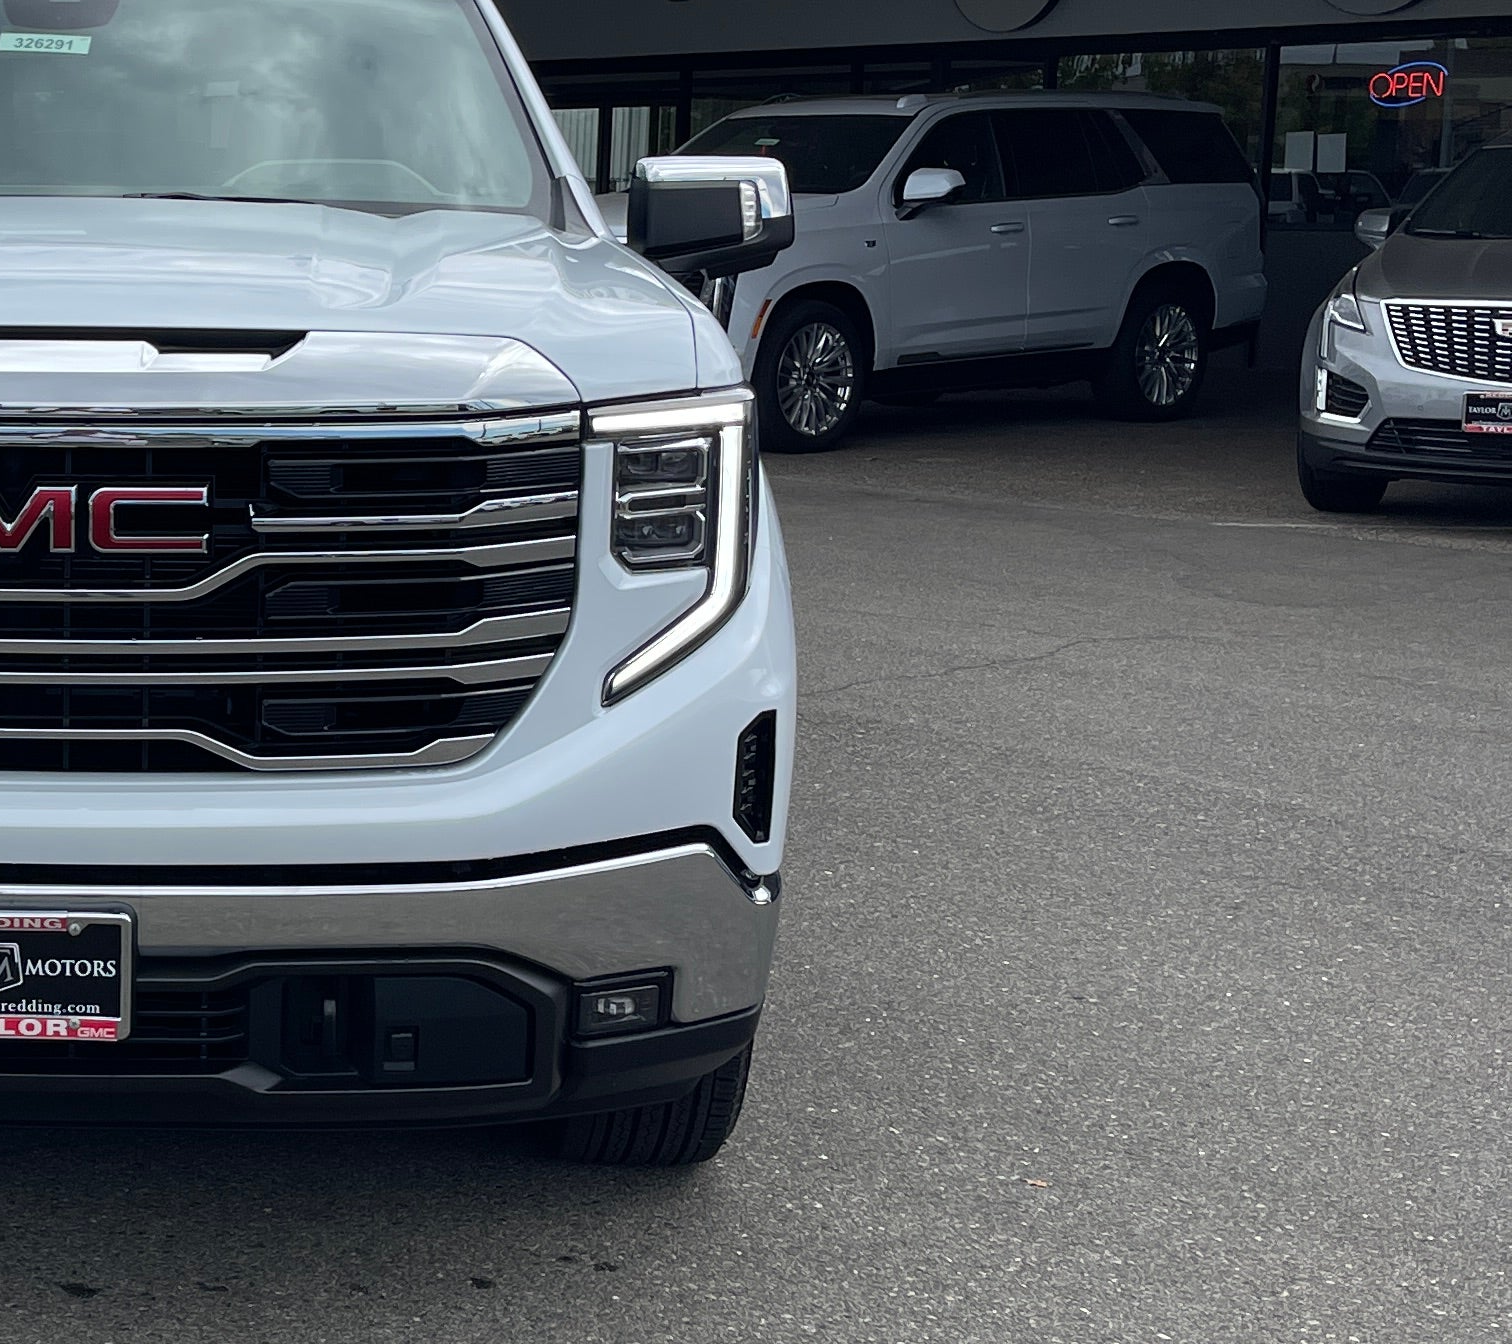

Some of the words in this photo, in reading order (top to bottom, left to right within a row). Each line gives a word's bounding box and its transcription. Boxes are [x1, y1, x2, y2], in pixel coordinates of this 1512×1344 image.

[14, 37, 74, 50] 326291
[1369, 71, 1445, 98] OPEN
[1468, 406, 1497, 414] TAYLOR
[24, 958, 116, 978] MOTORS
[77, 1027, 116, 1038] GMC
